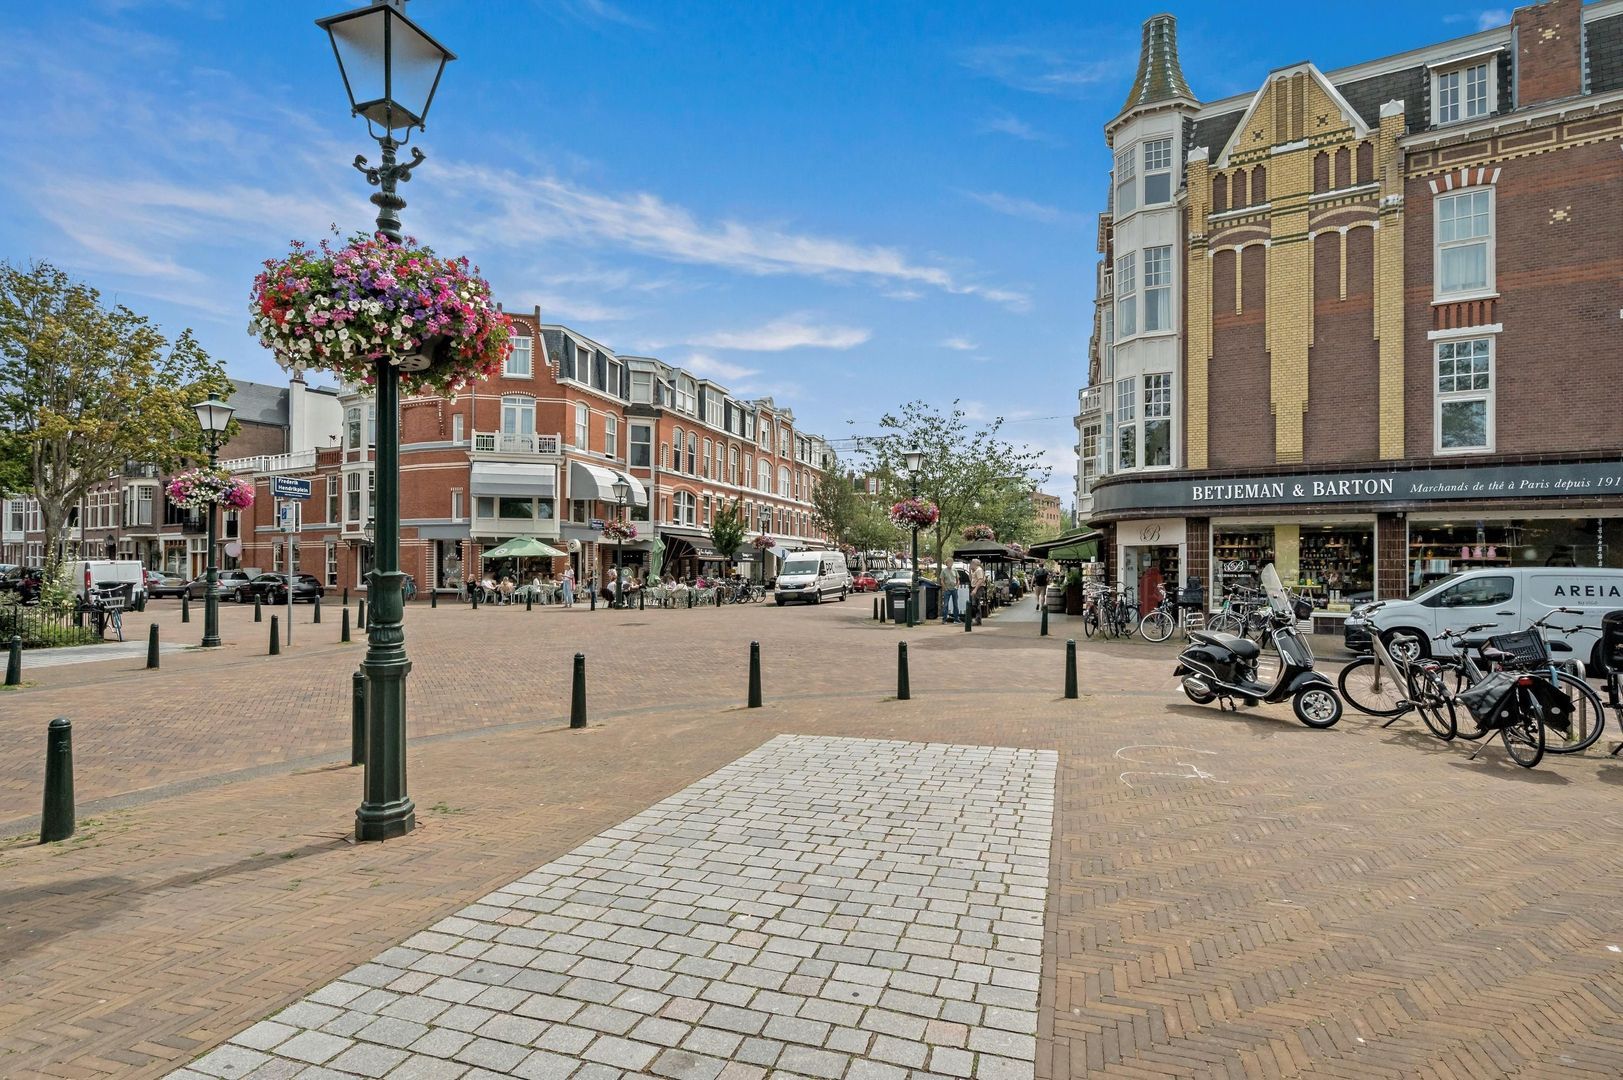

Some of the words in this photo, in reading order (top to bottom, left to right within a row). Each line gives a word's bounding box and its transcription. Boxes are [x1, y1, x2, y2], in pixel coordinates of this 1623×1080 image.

[278, 485, 308, 493] Hendrikplein
[1192, 483, 1285, 501] BETJEMAN
[1292, 483, 1305, 497] &
[1312, 478, 1394, 497] BARTON
[1410, 482, 1468, 493] Marchands
[1472, 481, 1484, 491] de
[1488, 481, 1505, 491] thé
[1508, 480, 1515, 490] à
[1519, 478, 1550, 489] Paris
[1554, 478, 1591, 490] depuis
[1596, 476, 1623, 488] 191
[1554, 585, 1621, 597] AREIA
